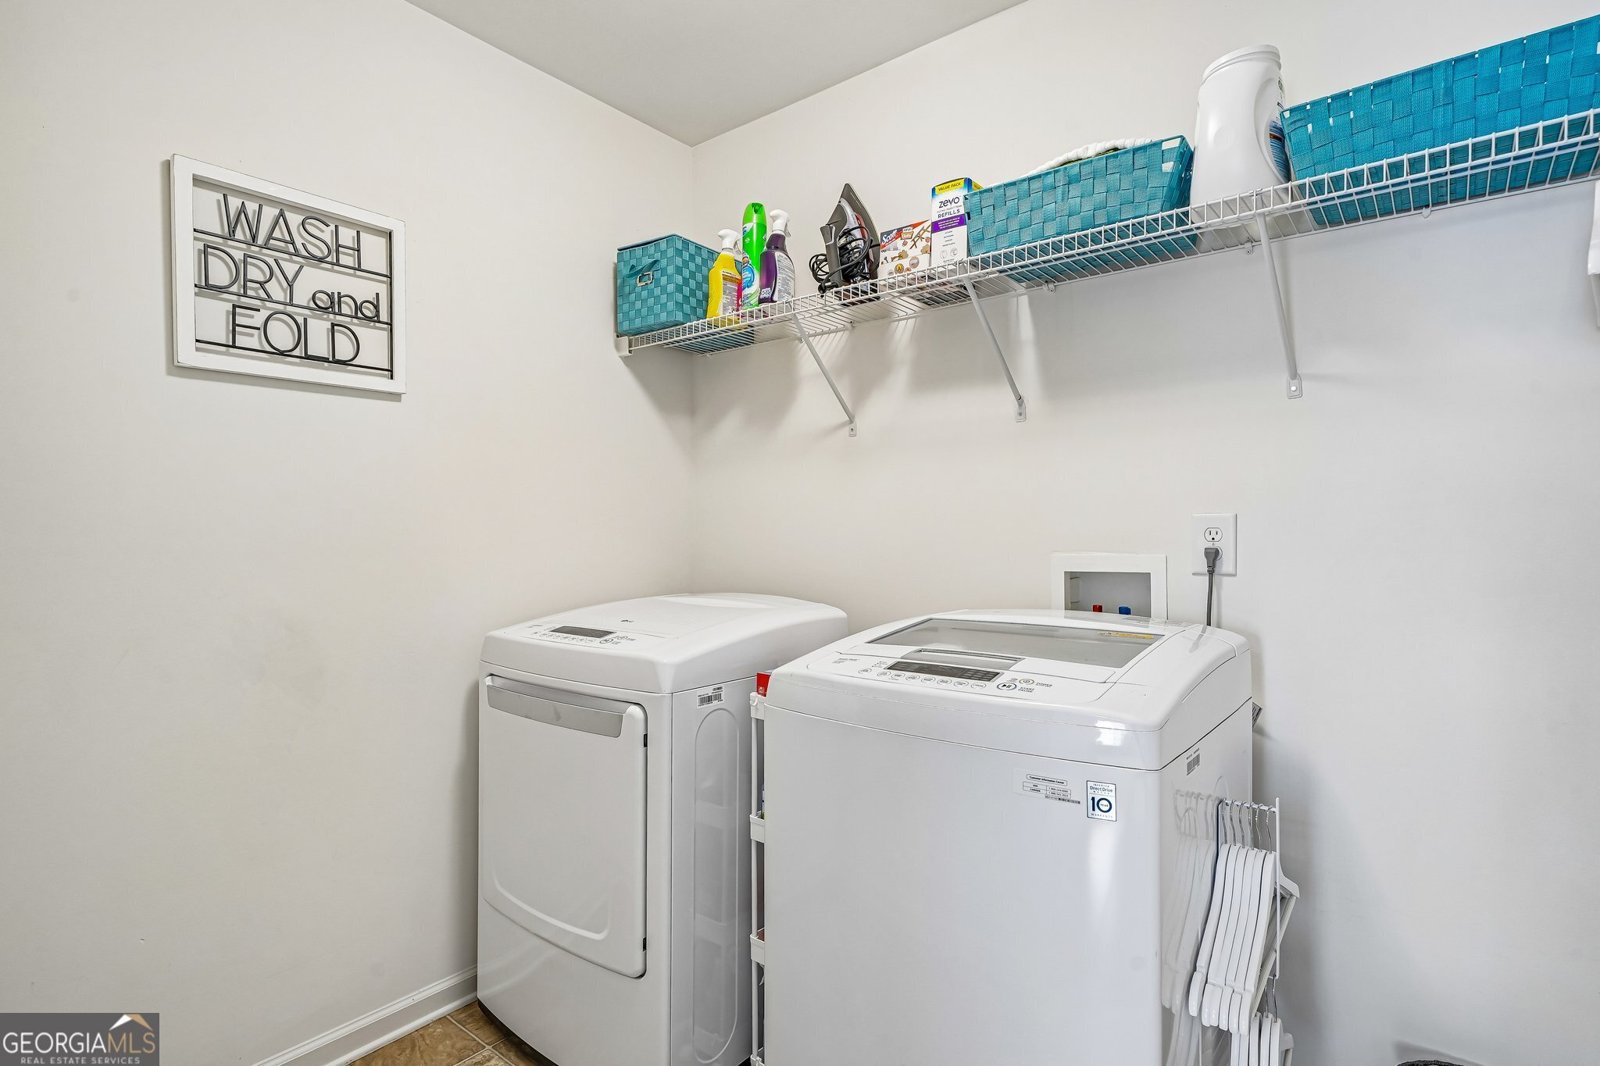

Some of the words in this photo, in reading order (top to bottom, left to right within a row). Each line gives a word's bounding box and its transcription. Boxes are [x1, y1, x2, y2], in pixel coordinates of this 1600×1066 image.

[222, 193, 361, 270] WASH
[937, 208, 961, 219] REFILLS
[203, 243, 304, 306] DRY
[311, 290, 380, 323] and
[232, 303, 361, 364] FOLD
[1091, 796, 1113, 813] 10
